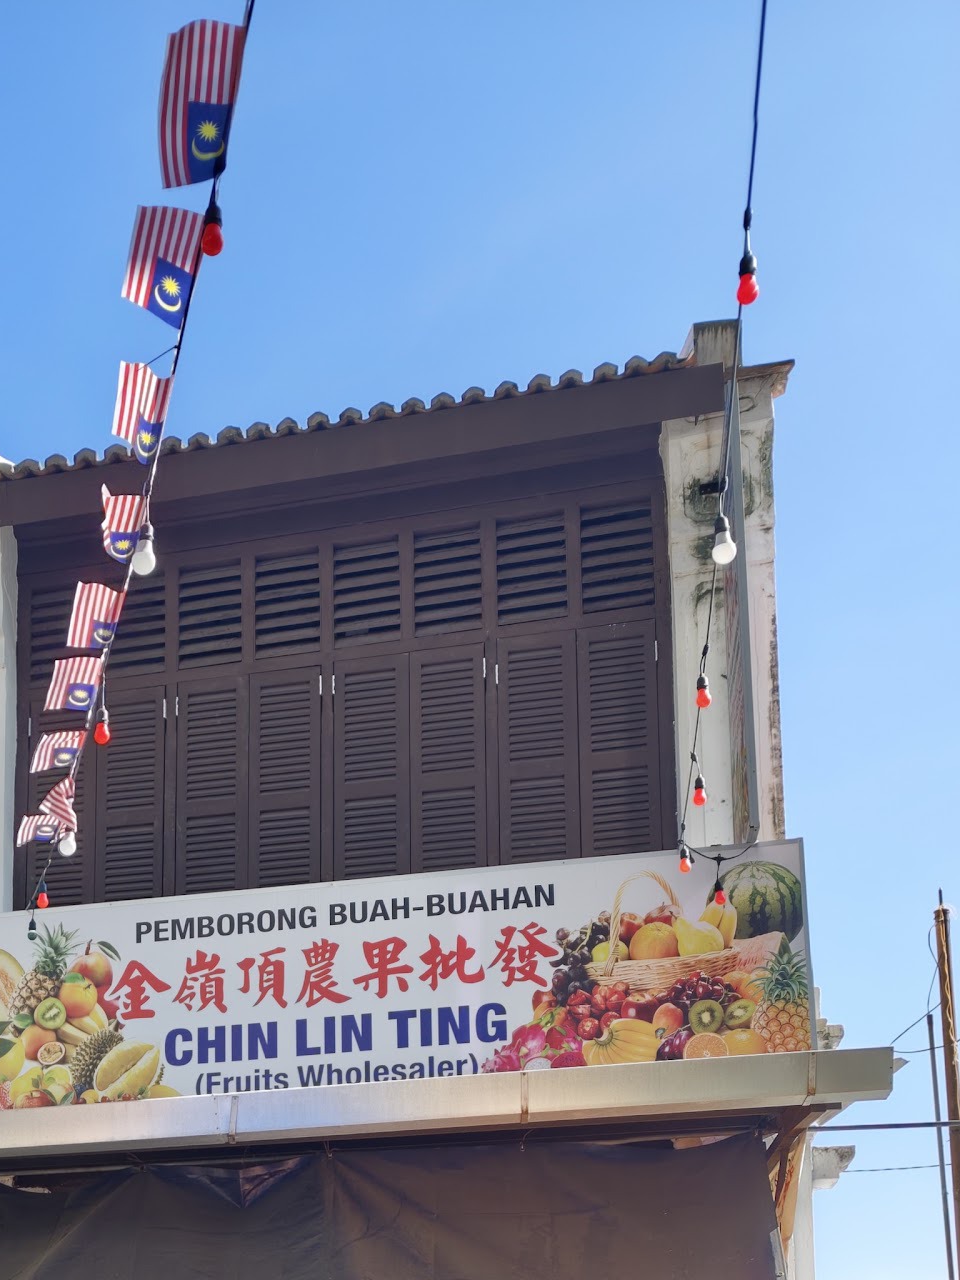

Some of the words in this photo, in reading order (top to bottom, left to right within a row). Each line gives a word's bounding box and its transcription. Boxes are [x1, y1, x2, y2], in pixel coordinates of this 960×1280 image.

[135, 906, 317, 943] PEMBORONG
[329, 884, 555, 926] BUAH-BUAHAN
[109, 921, 558, 1020] 金嶺頂農果批發
[164, 1021, 277, 1066] CHIN
[295, 1013, 372, 1057] LIN
[388, 1002, 508, 1047] TING
[195, 1067, 289, 1095] (Fruits
[297, 1053, 479, 1089] Wholesaler)
